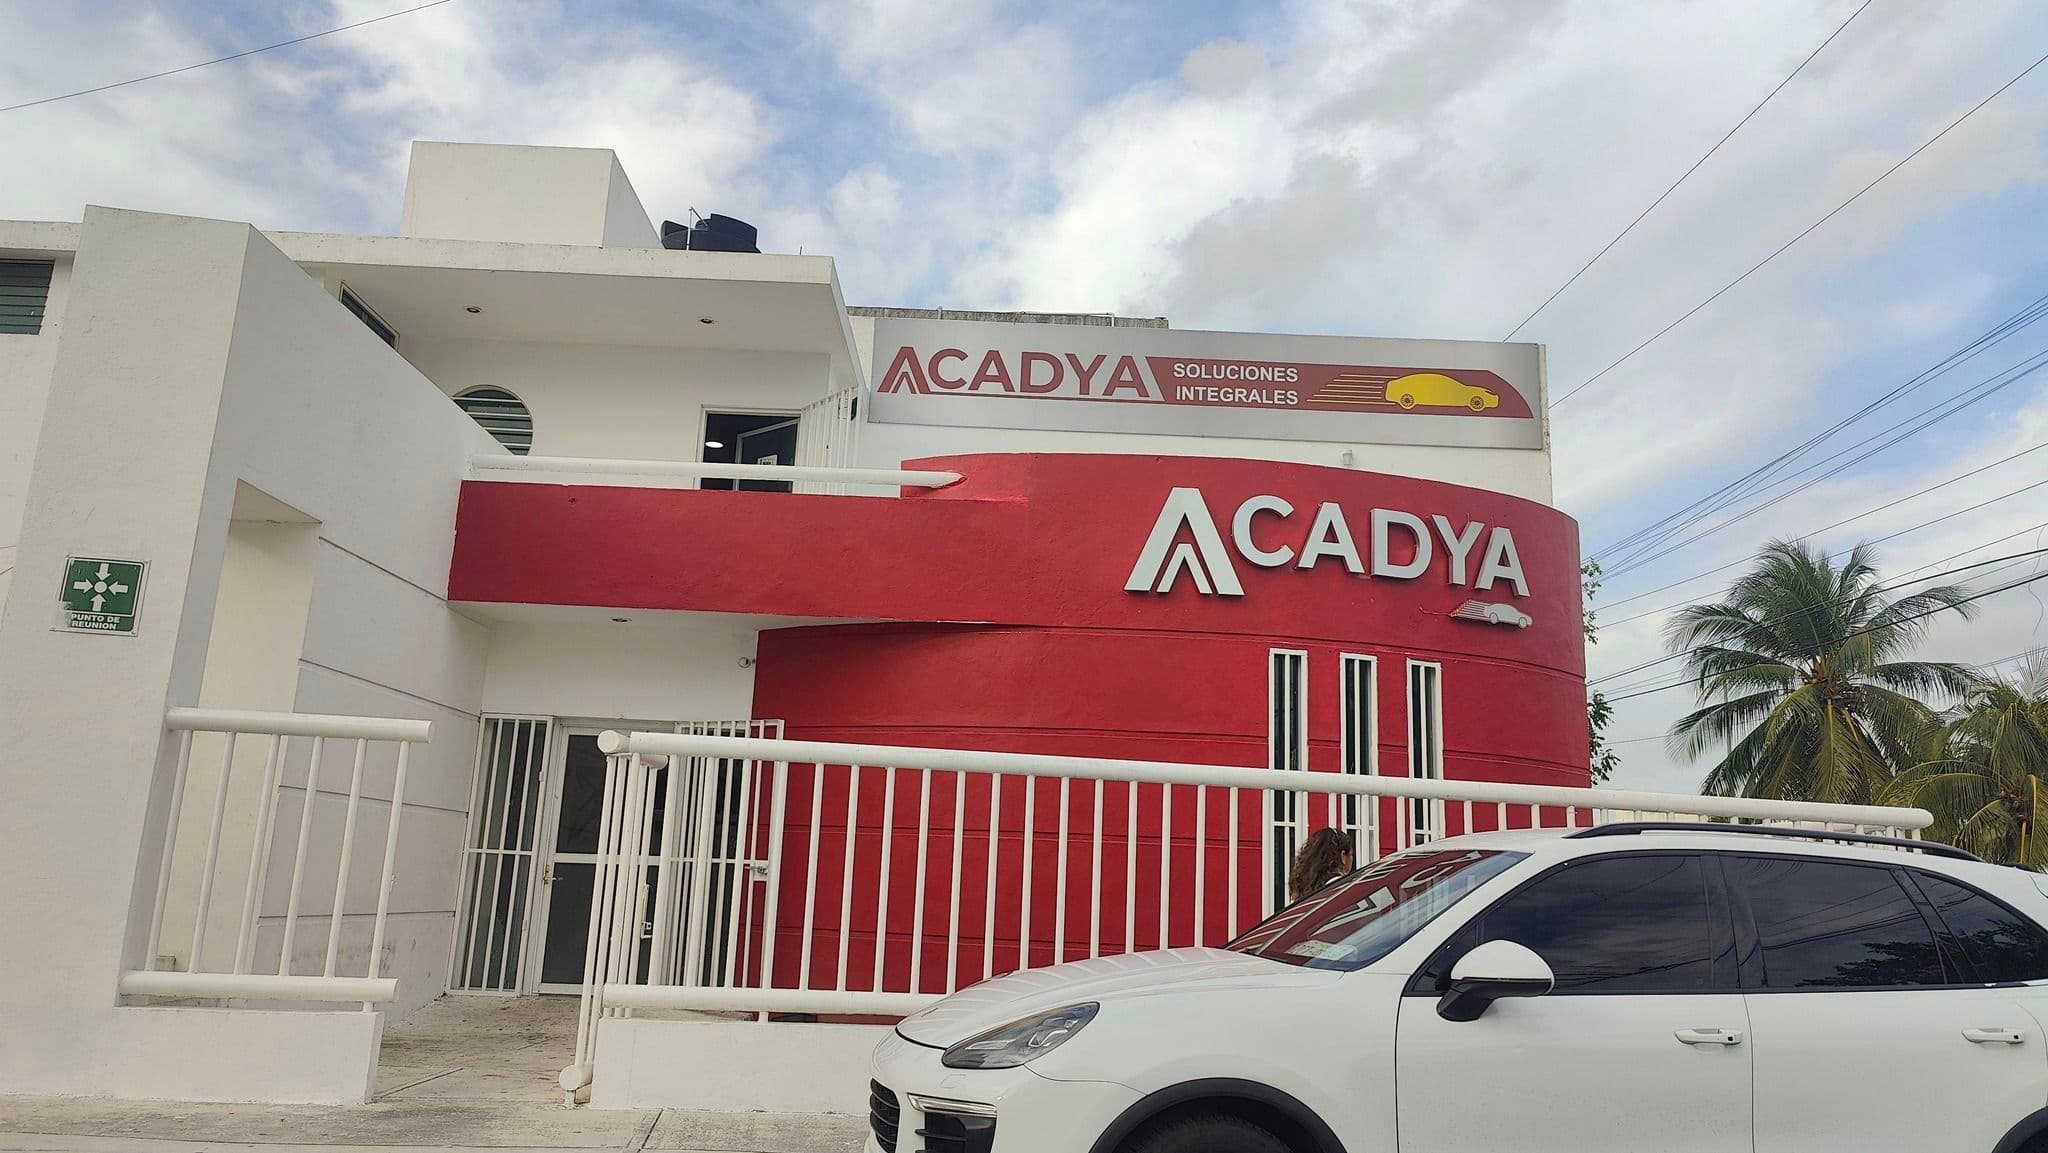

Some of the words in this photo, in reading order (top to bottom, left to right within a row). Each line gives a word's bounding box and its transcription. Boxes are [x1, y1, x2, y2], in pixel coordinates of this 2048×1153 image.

[877, 346, 1150, 398] ACADYA
[1173, 362, 1298, 382] SOLUCIONES
[1175, 387, 1298, 405] INTEGRALES
[1124, 487, 1530, 597] ACADYA
[71, 613, 104, 622] PUNTO
[71, 620, 117, 630] REUNION
